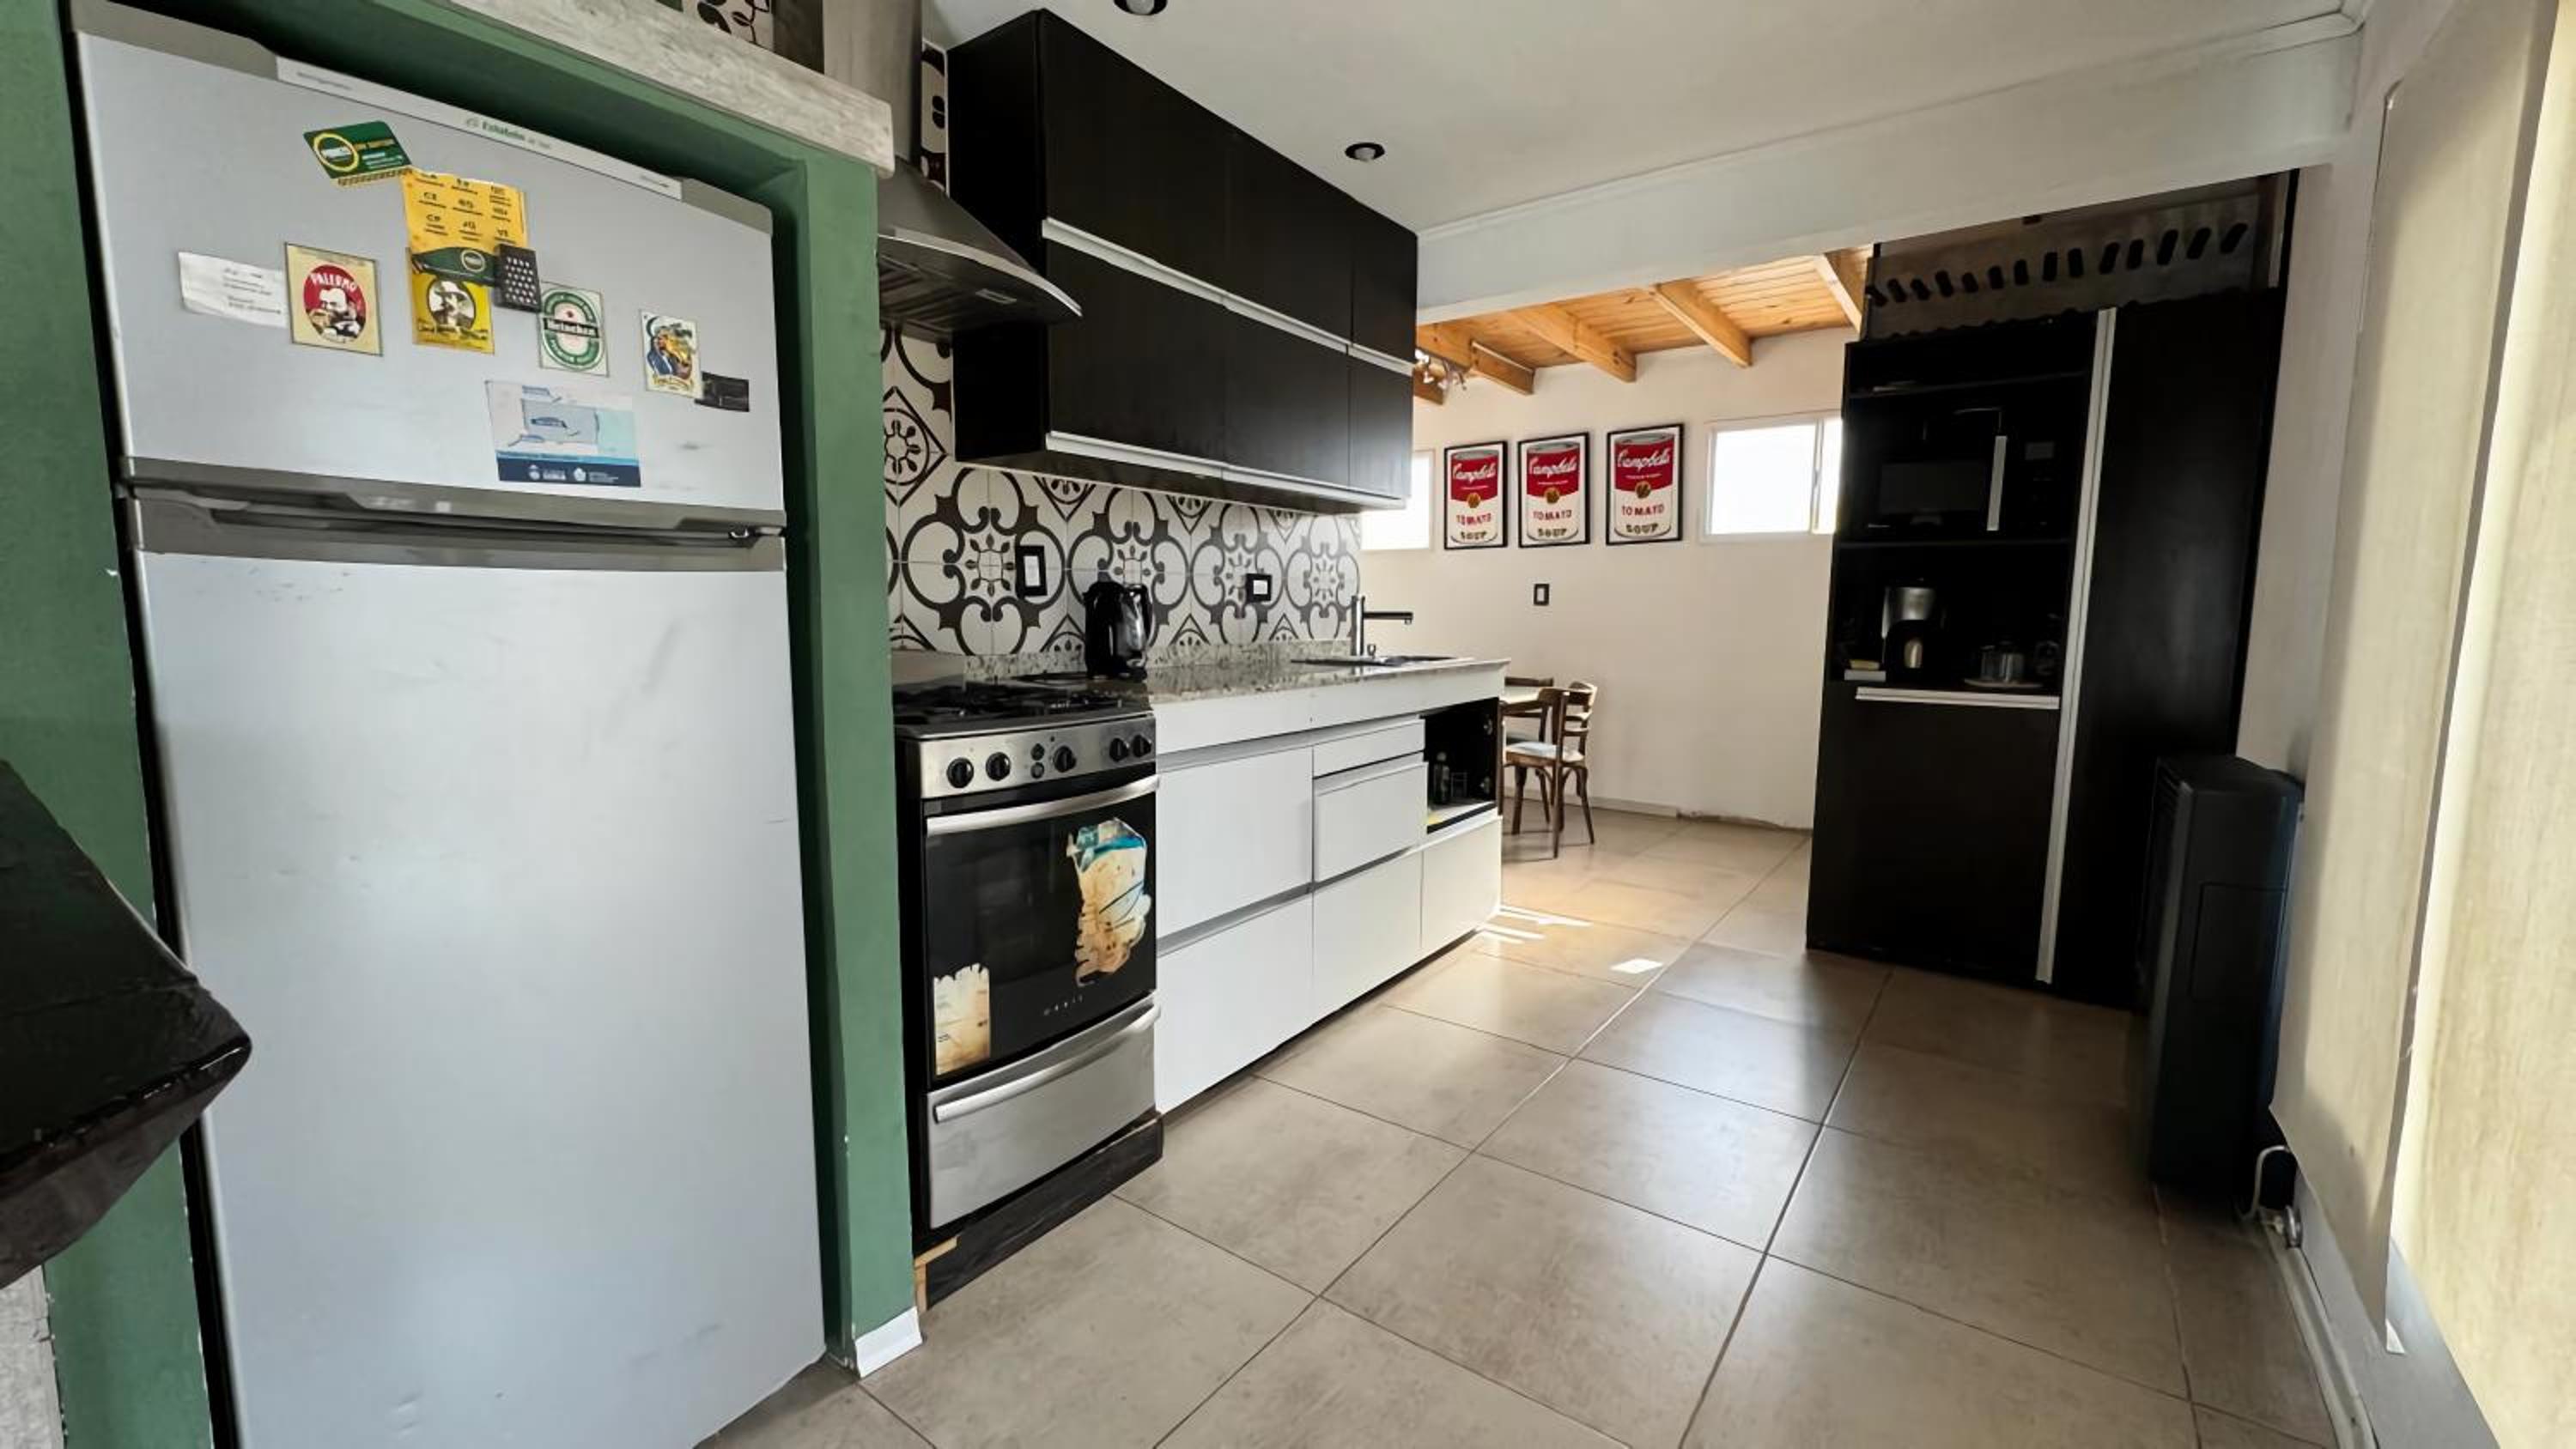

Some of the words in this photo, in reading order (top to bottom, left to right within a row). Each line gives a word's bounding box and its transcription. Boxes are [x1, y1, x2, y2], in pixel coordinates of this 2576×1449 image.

[310, 271, 357, 294] PALERMO
[548, 318, 596, 337] Heineken
[1533, 509, 1572, 521] TOMATO
[1621, 504, 1664, 516] TOMATO
[1455, 512, 1492, 525] TOMATO
[1537, 528, 1567, 537] SOUP
[1625, 523, 1658, 534] SOUP
[1460, 530, 1487, 541] SOUP
